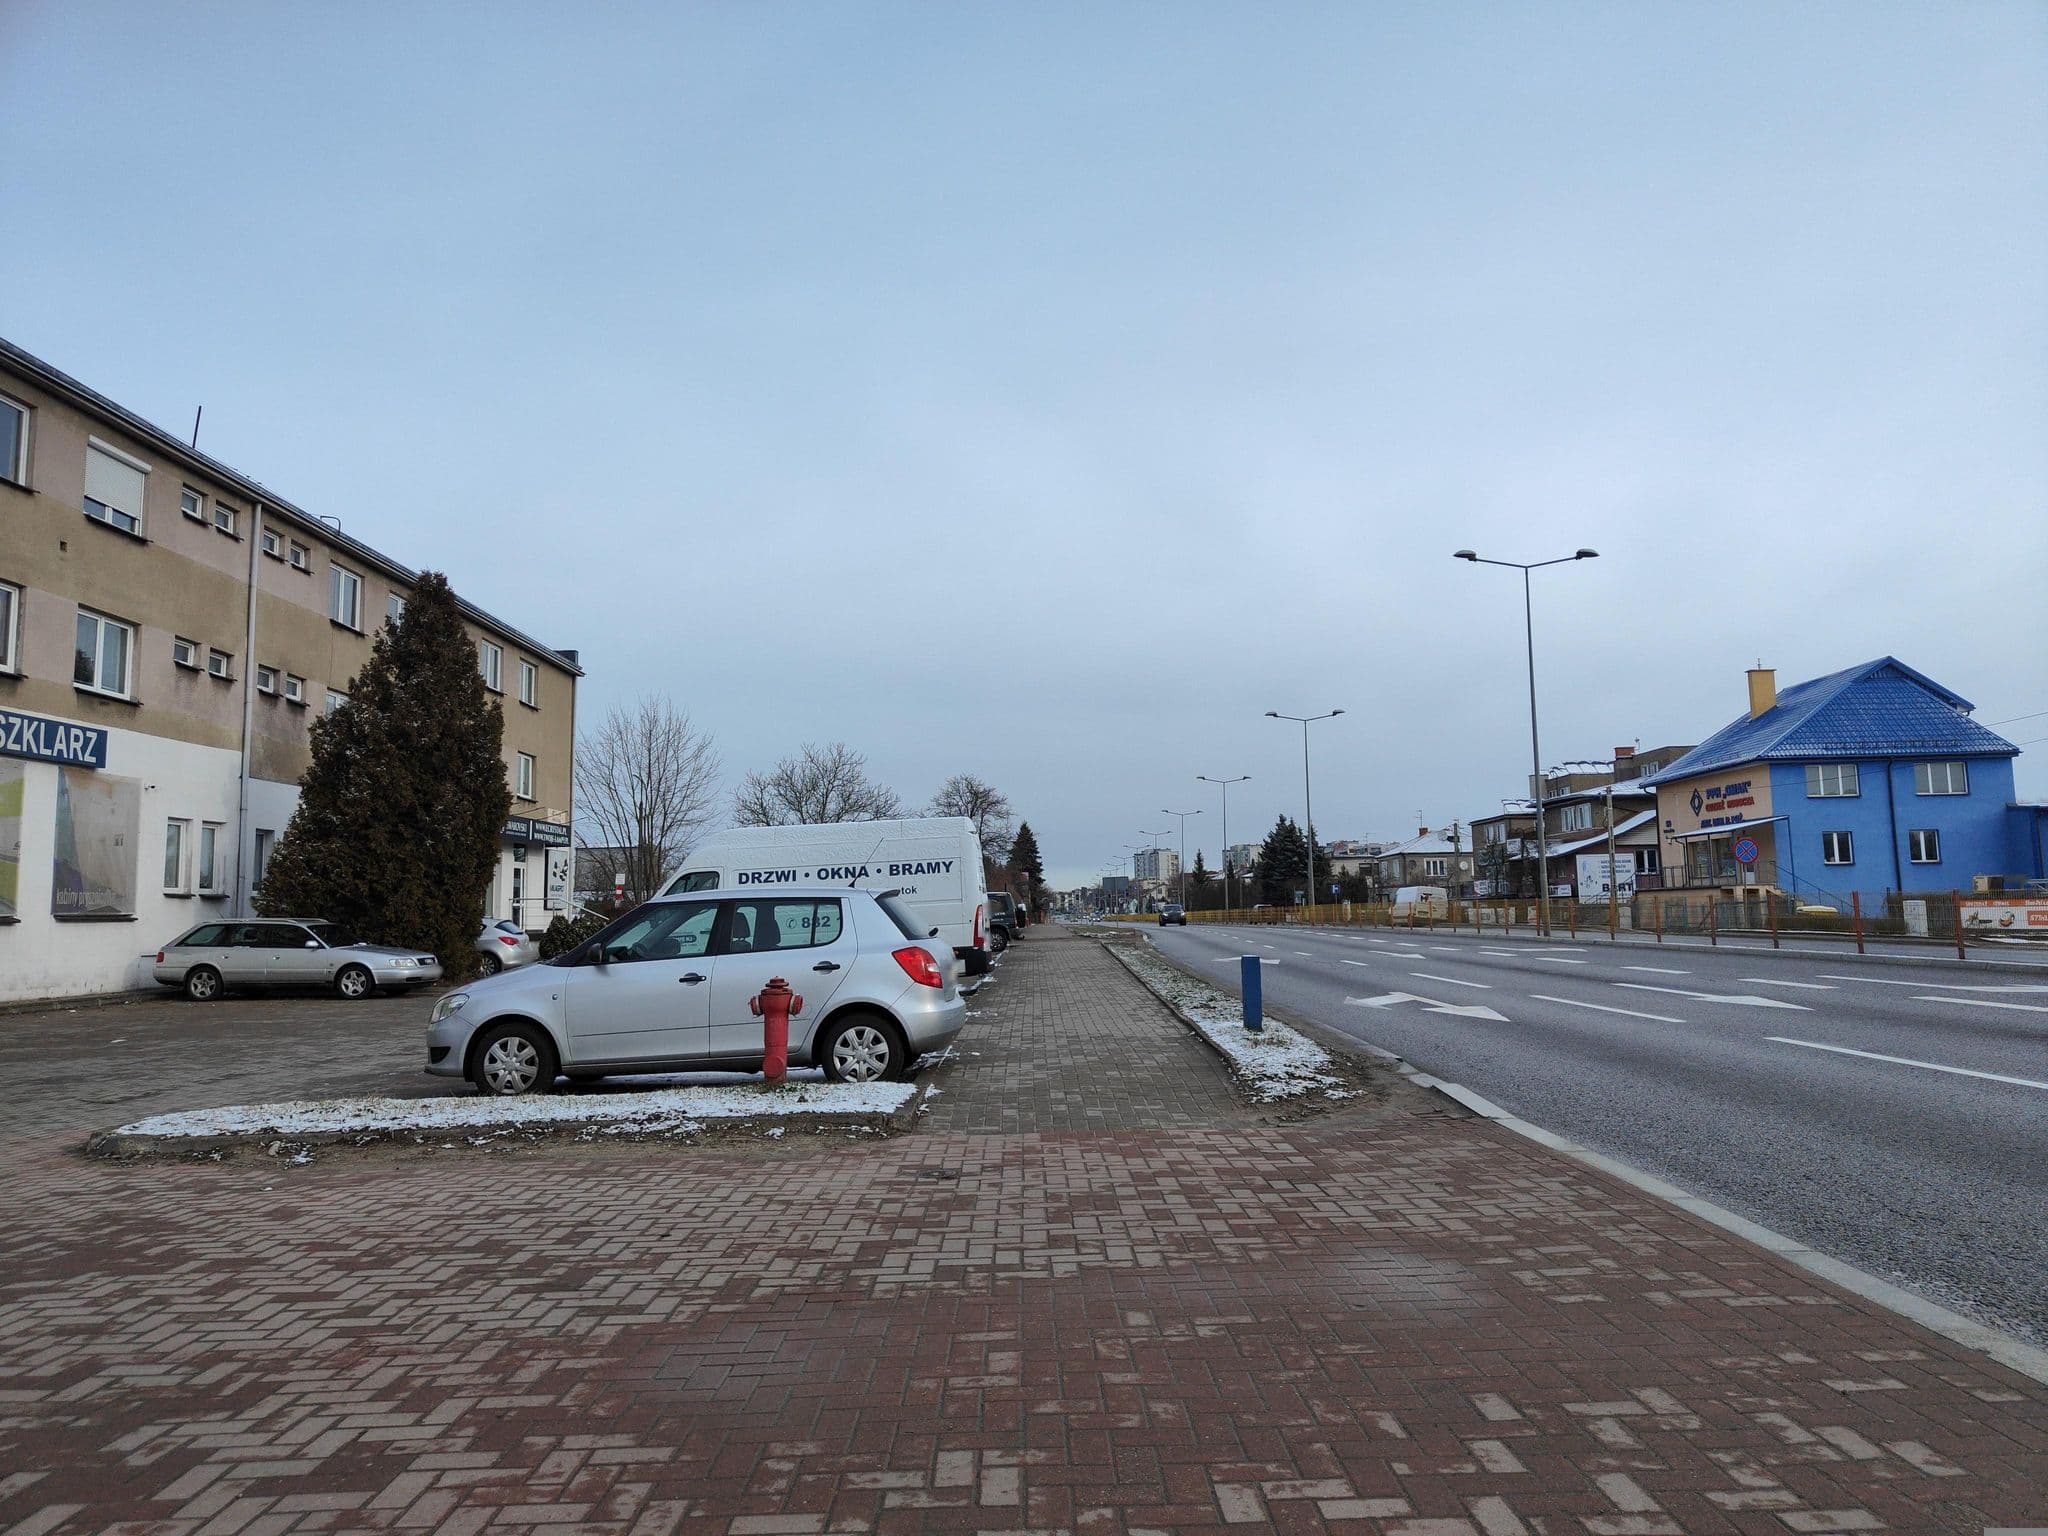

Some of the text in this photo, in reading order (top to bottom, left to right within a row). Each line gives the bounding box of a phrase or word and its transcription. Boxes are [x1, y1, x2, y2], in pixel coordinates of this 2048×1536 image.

[738, 861, 953, 884] DRZWI OKNA BRAMY
[900, 886, 918, 895] tok
[1602, 883, 1633, 892] BRT
